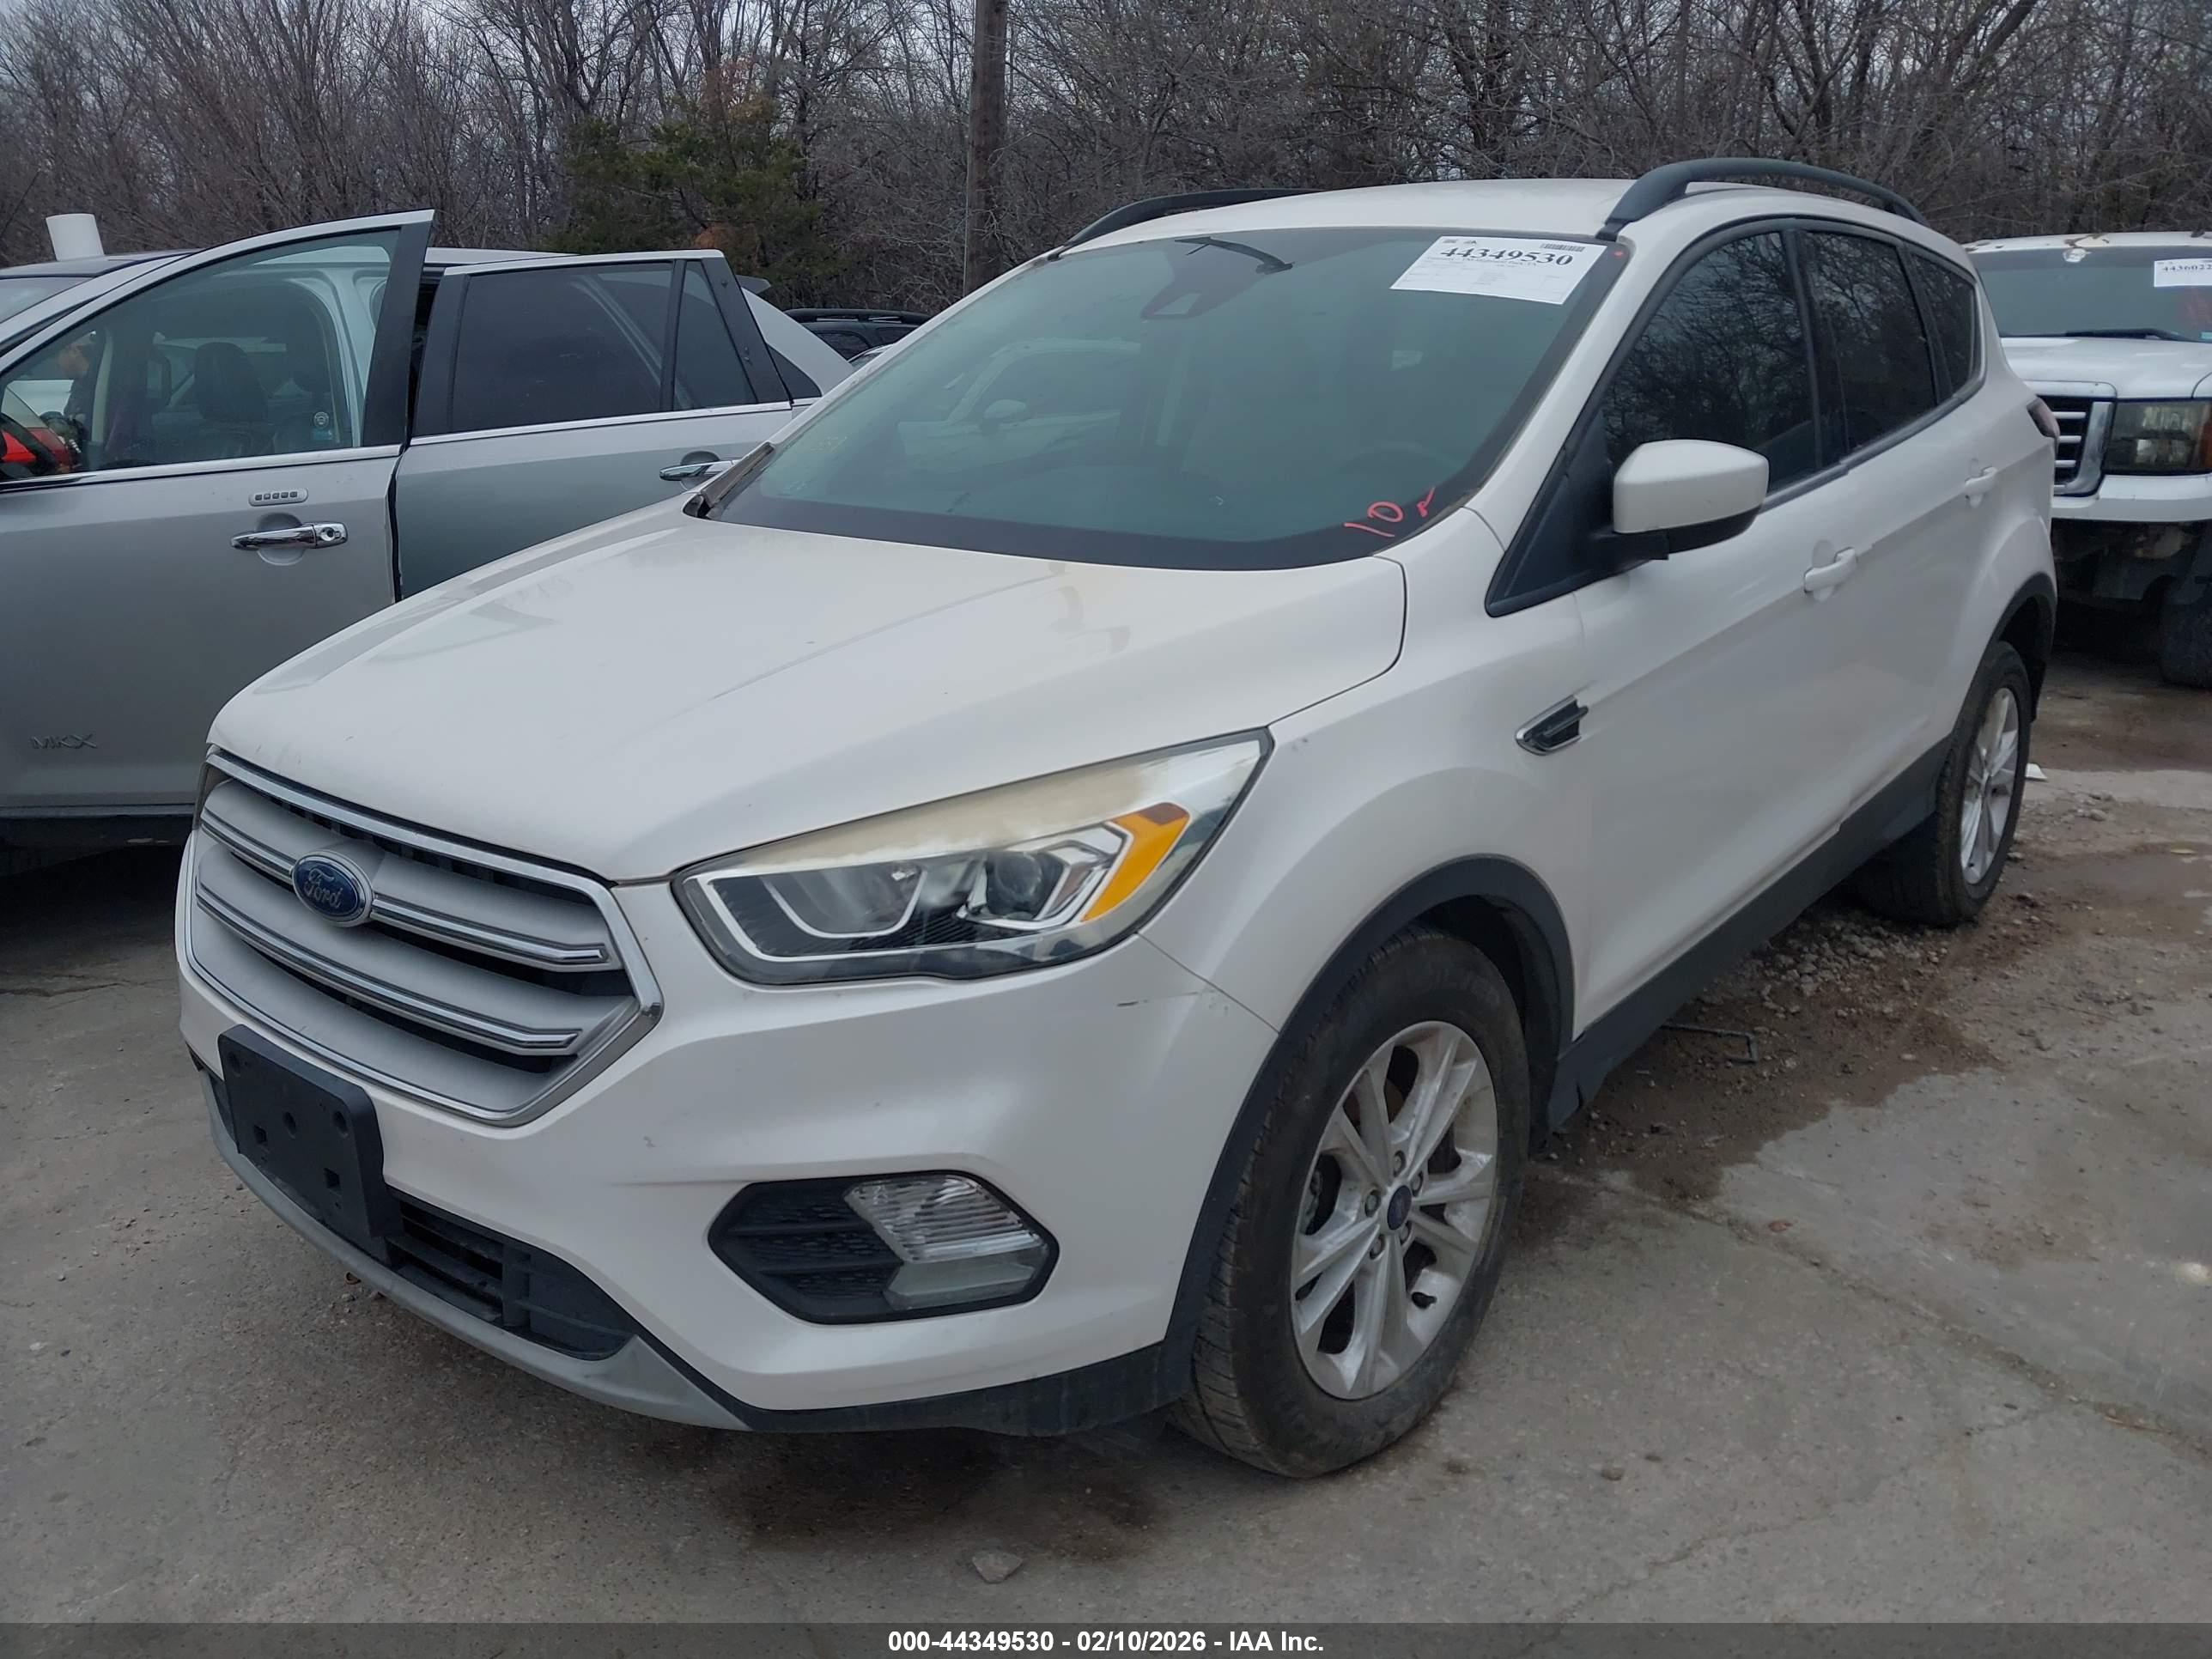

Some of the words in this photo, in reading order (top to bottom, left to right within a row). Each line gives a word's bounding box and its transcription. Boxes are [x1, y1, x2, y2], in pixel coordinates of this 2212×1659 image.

[1440, 246, 1574, 266] 44349530
[29, 732, 98, 750] MKX
[303, 867, 343, 909] Ford
